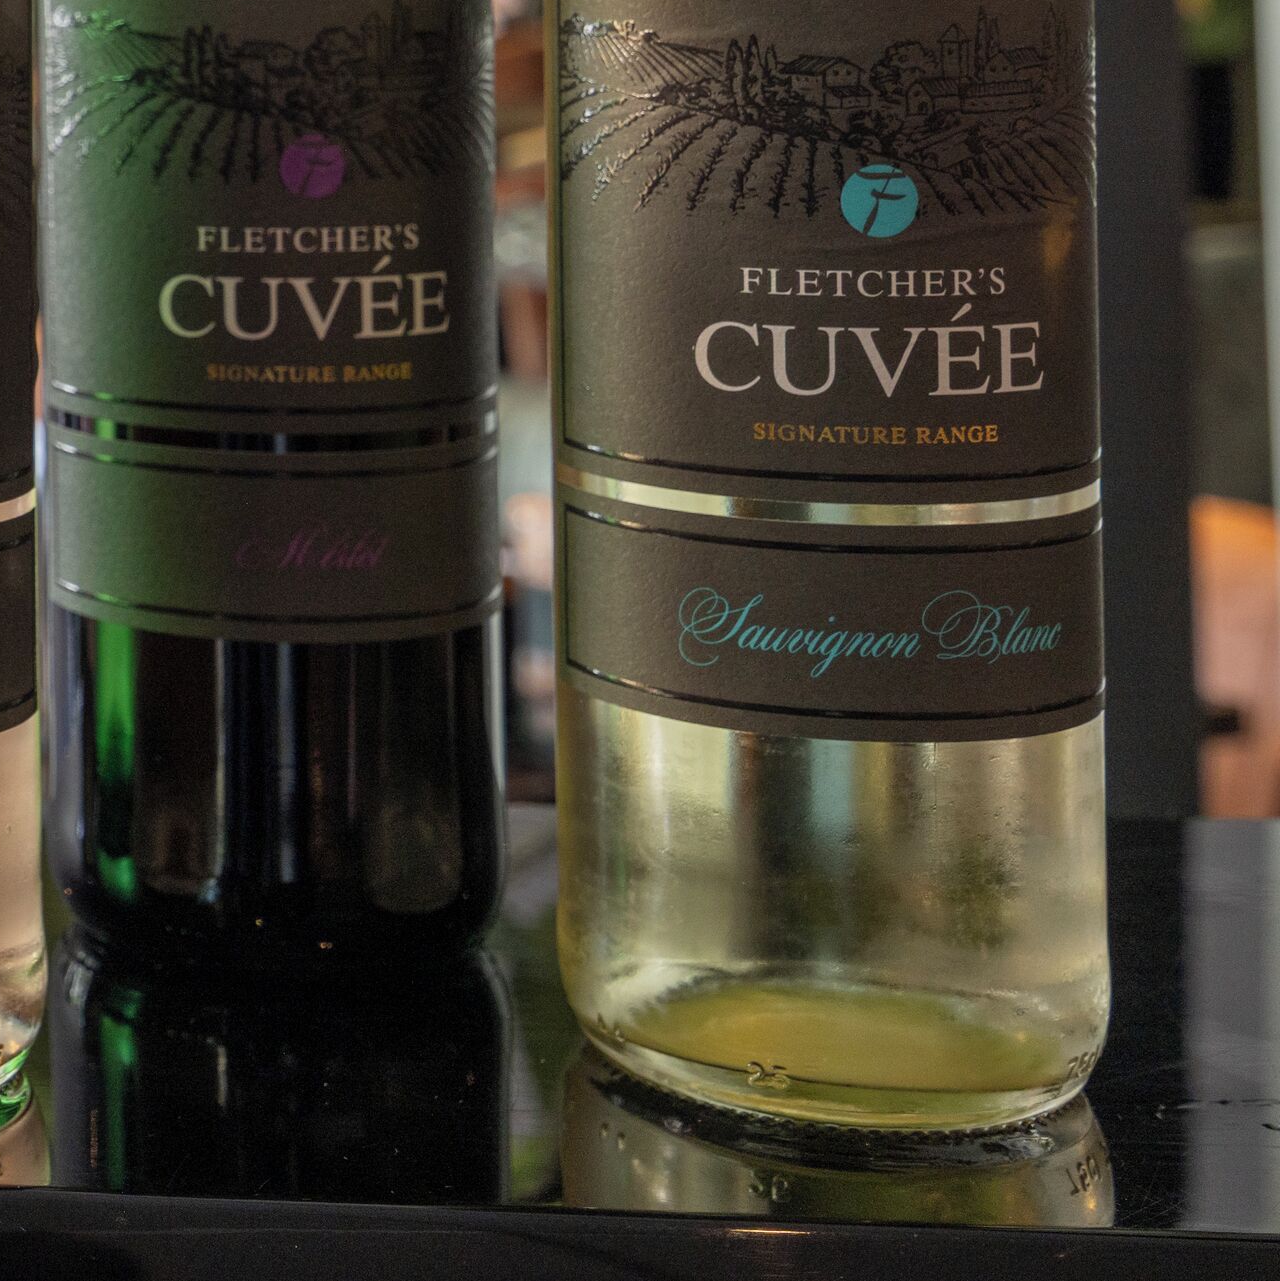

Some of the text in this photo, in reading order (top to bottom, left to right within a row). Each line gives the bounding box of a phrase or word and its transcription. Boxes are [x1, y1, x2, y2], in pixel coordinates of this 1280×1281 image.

[197, 223, 419, 253] FLETCHER'S
[158, 254, 450, 342] CUVÉE
[740, 266, 1005, 298] FLETCHER'S
[694, 302, 1044, 398] CUVÉE
[207, 362, 412, 384] SIGNATURE RANGE
[753, 423, 999, 445] SIGNATURE RANGE
[678, 586, 1062, 678] Sauvignon Blanc
